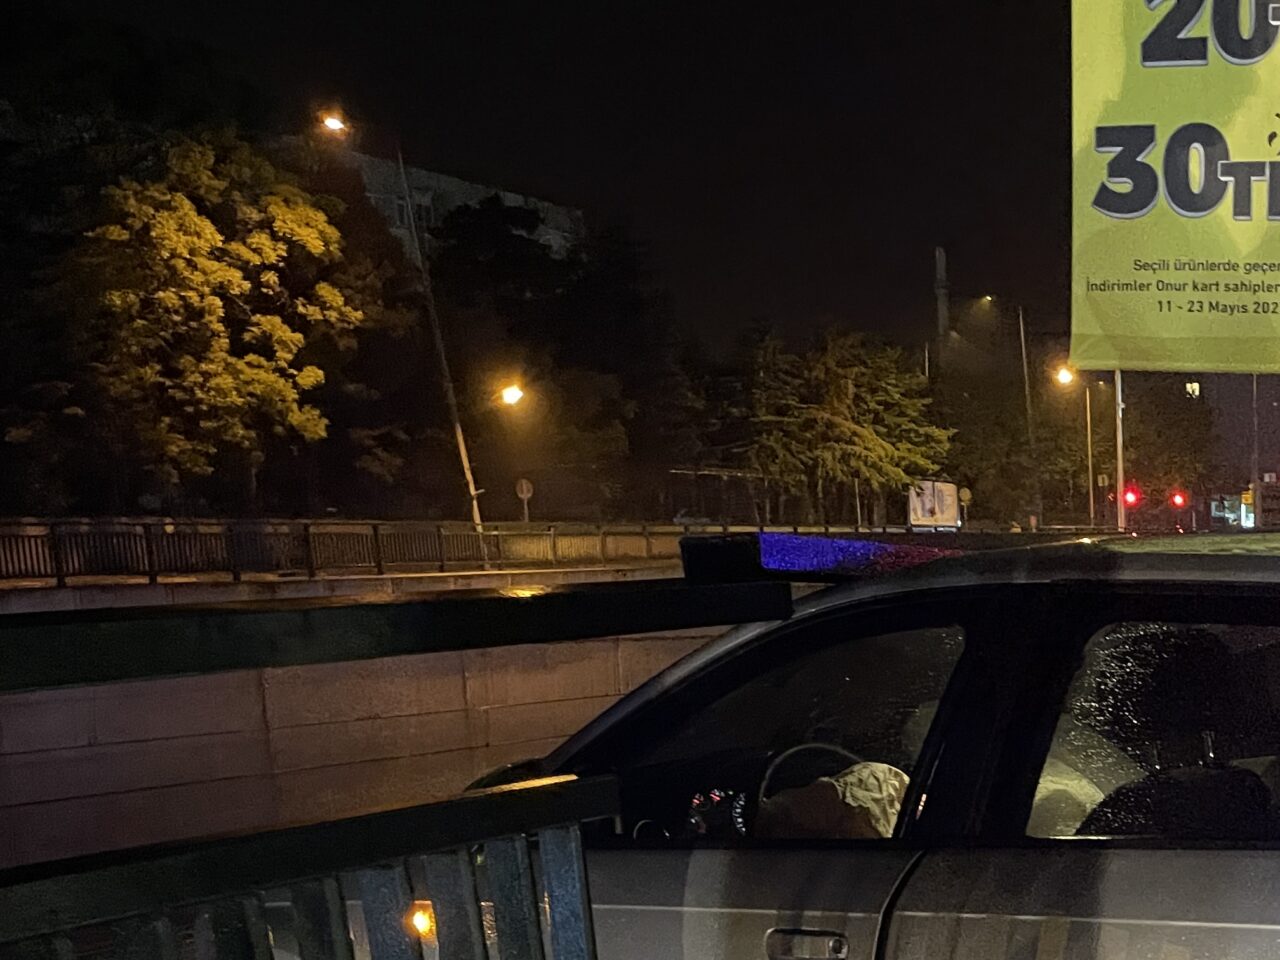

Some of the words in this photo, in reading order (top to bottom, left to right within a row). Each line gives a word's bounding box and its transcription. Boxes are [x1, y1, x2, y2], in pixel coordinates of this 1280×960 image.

[1132, 259, 1170, 274] Seçili
[1173, 258, 1239, 272] ürünlerde
[1086, 276, 1152, 292] İndirimler
[1156, 280, 1188, 292] Onur
[1192, 280, 1220, 292] kart
[1157, 301, 1172, 313] 11
[1187, 301, 1204, 313] 23
[1208, 301, 1248, 316] Mayıs
